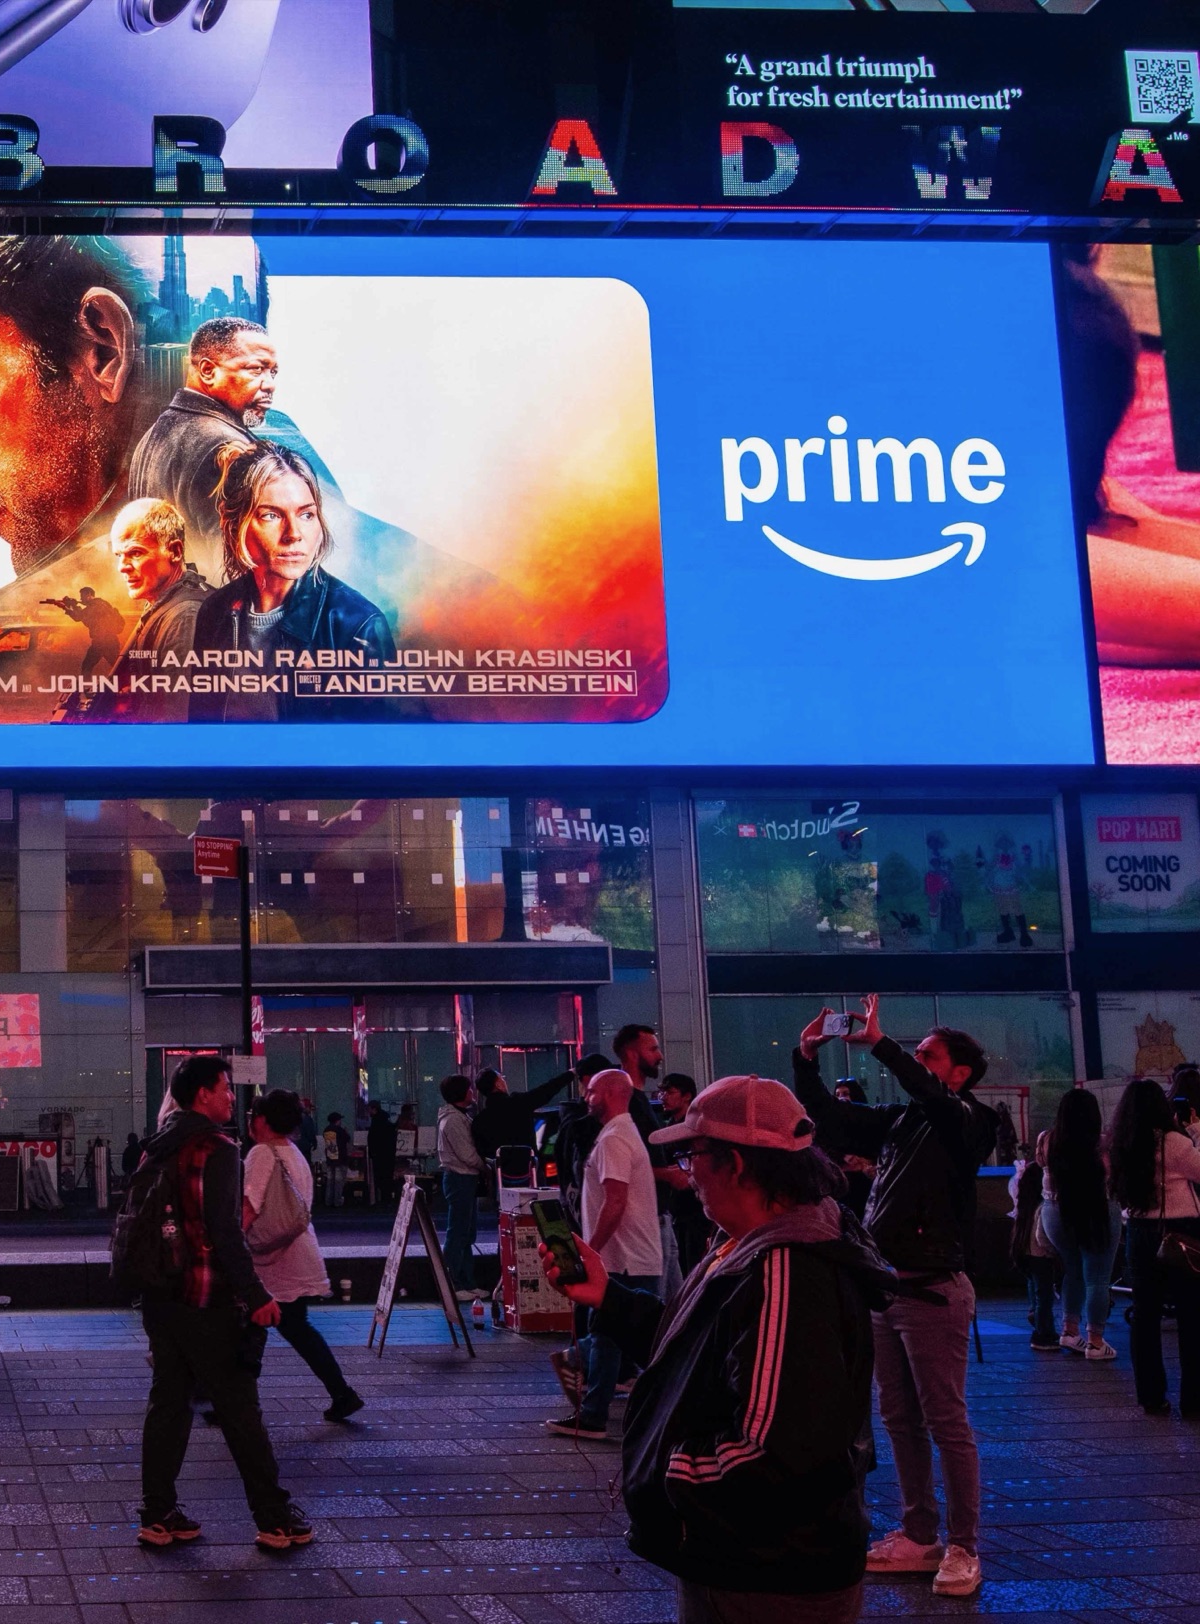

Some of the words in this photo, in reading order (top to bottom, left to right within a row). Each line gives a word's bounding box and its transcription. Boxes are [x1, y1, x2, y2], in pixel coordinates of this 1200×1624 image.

[760, 54, 832, 82] grand
[836, 56, 936, 83] triumph
[727, 85, 763, 107] for
[767, 85, 830, 107] fresh
[834, 88, 1023, 110] entertainment!”
[720, 414, 1006, 522] prime
[161, 649, 264, 668] AARON
[275, 649, 364, 668] RABIN
[384, 649, 464, 668] JOHN
[475, 649, 632, 668] KRASINSKI
[37, 675, 119, 693] JOHN
[130, 674, 289, 693] KRASINSKI
[324, 674, 456, 693] ANDREW
[467, 674, 633, 693] BERNSTEIN
[1102, 819, 1132, 839] POP
[1135, 820, 1178, 839] MART
[196, 840, 206, 849] NO
[206, 841, 234, 851] STOPPING
[197, 850, 220, 859] Anytime
[1105, 855, 1181, 875] COMING
[1117, 873, 1171, 893] SOON
[40, 1105, 86, 1113] VORNADO
